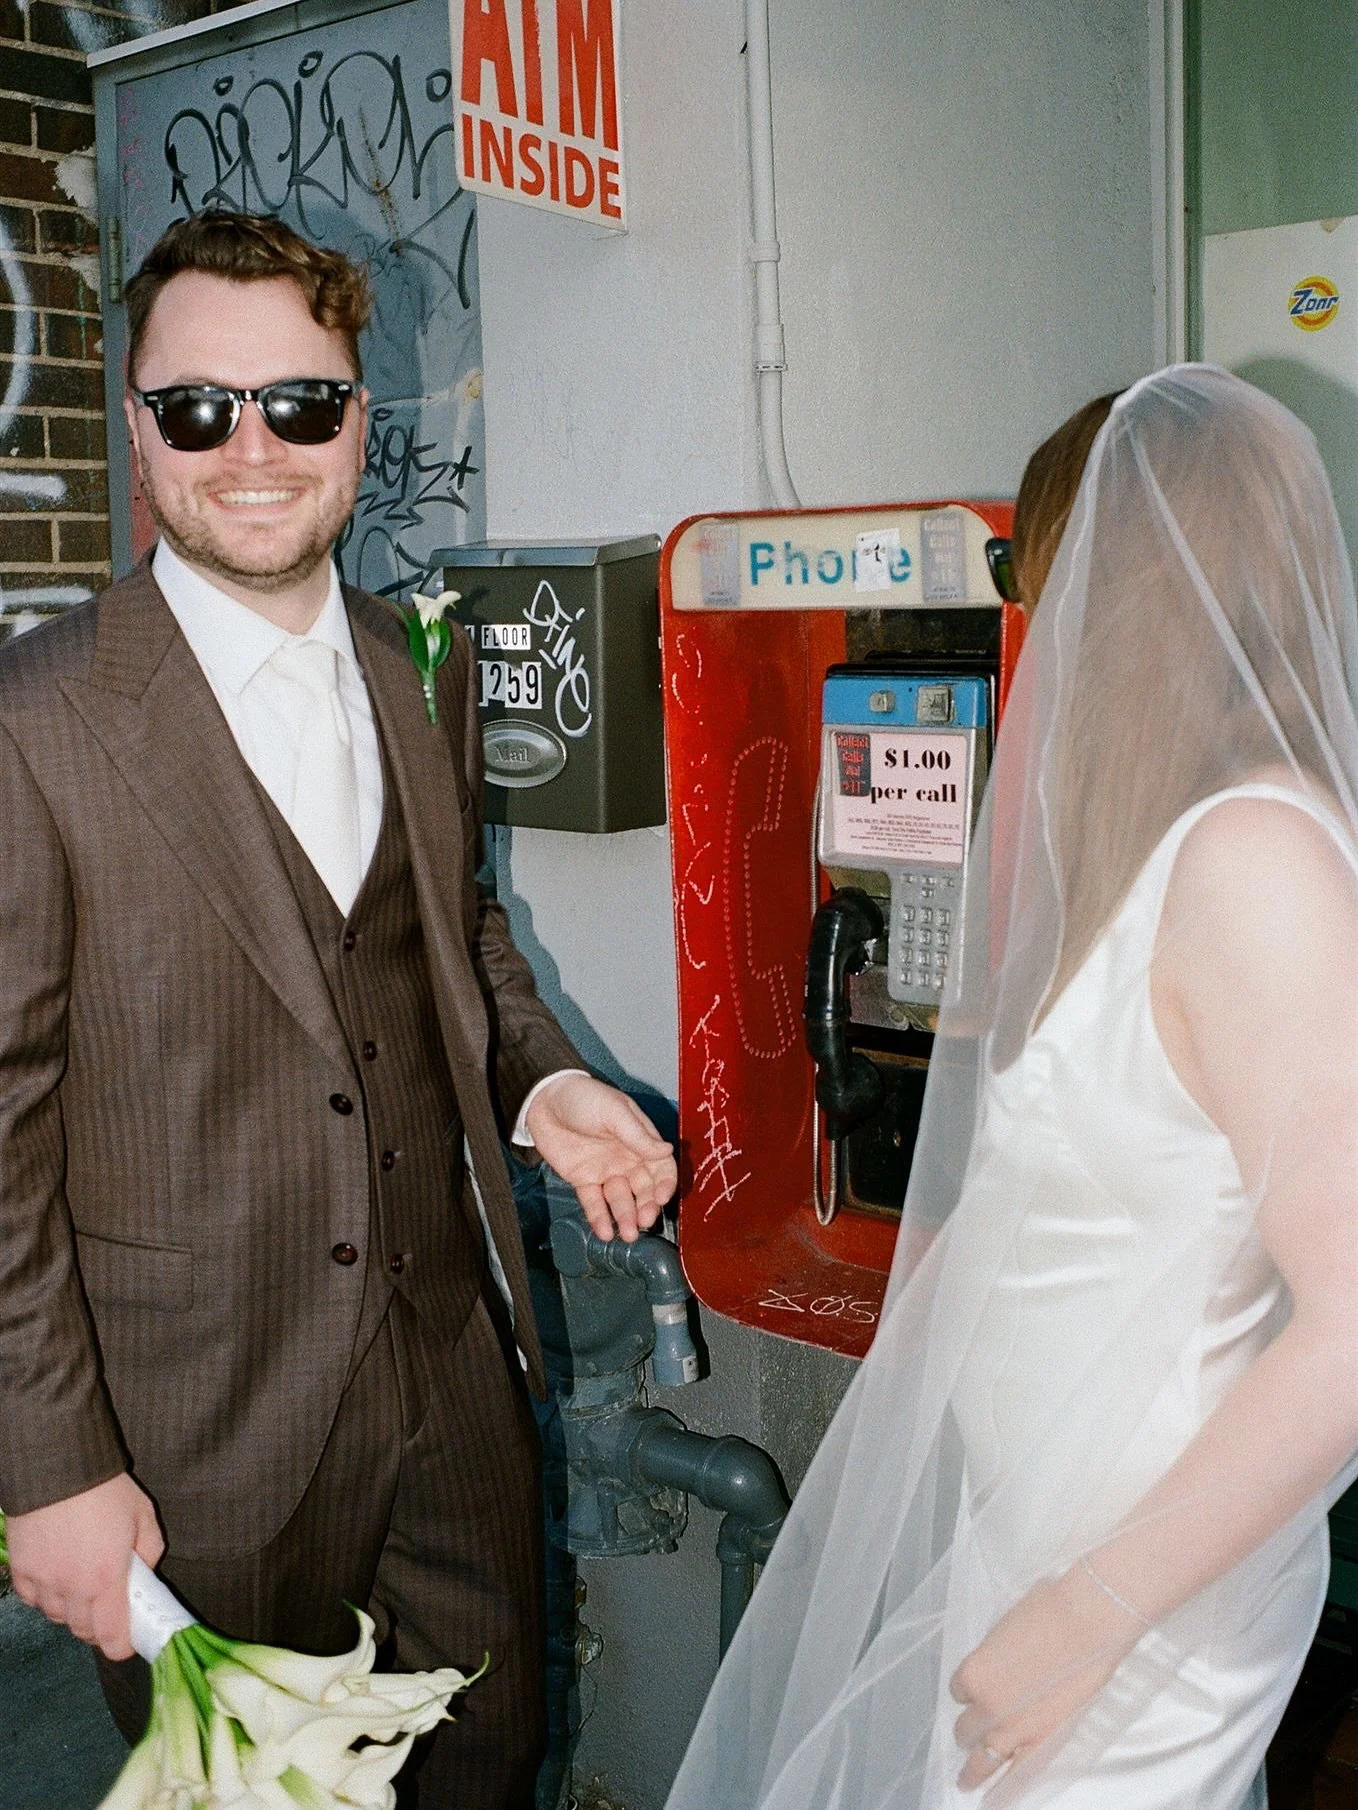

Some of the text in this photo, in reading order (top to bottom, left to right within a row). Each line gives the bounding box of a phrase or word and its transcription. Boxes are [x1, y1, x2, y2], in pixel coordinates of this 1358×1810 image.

[461, 113, 622, 220] INSIDE
[750, 541, 912, 585] Phoe
[484, 627, 528, 646] FLOOR
[884, 747, 951, 770] $1.00
[871, 783, 957, 804] per call
